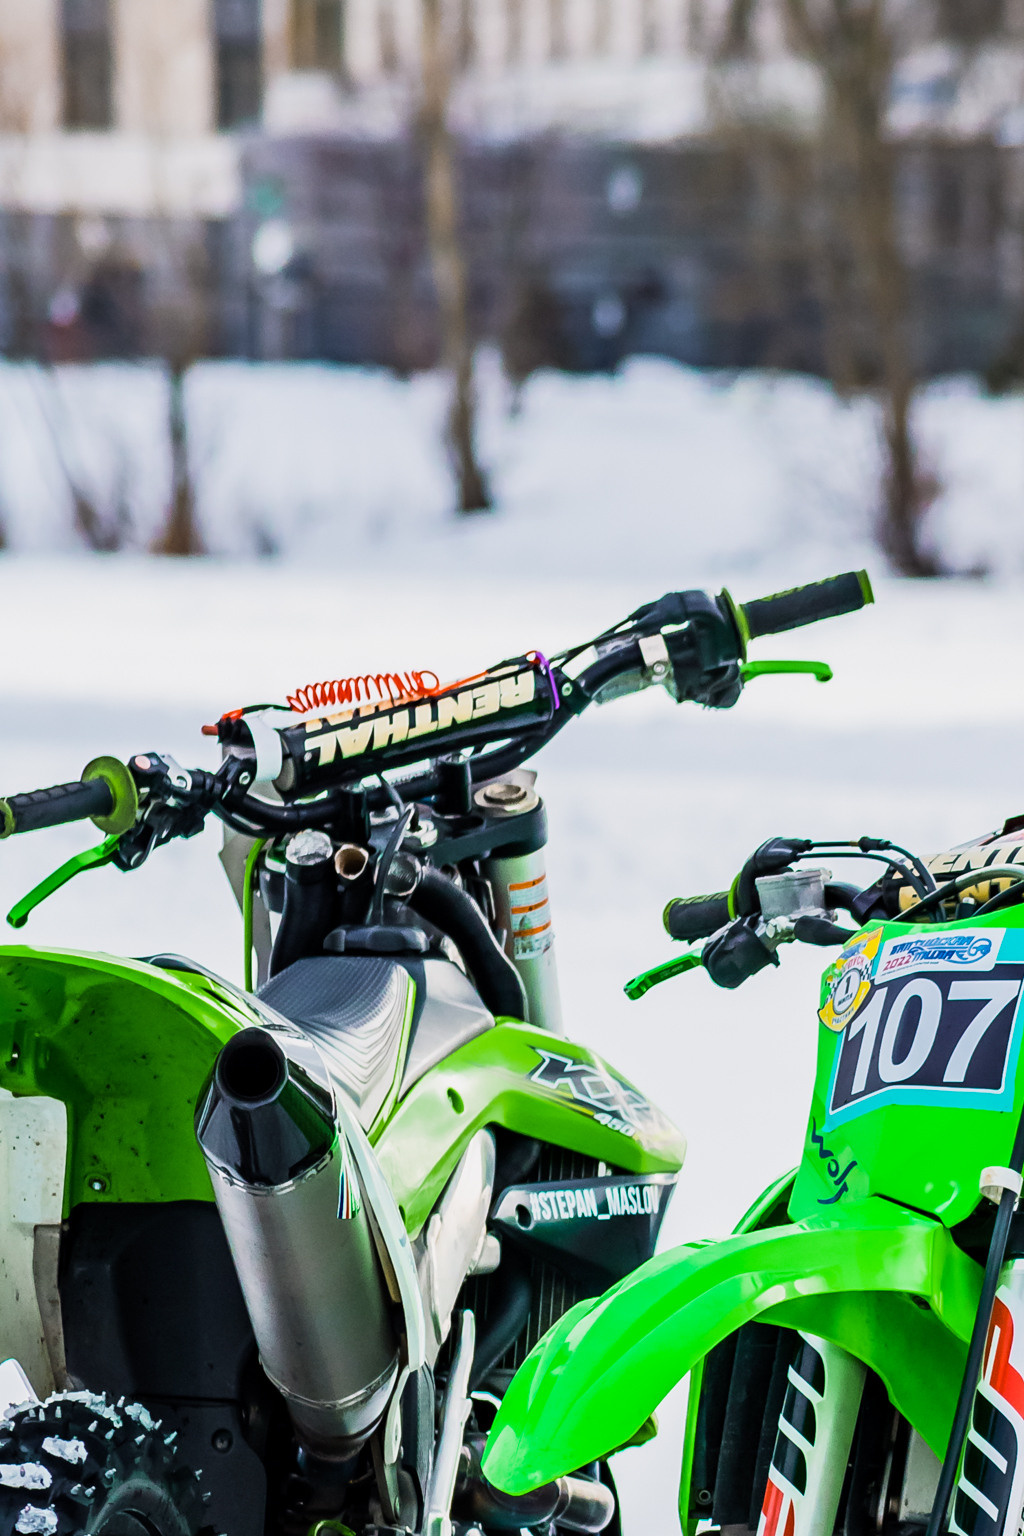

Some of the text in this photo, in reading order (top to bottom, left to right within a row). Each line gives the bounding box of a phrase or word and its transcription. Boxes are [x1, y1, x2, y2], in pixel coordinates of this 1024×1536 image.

[304, 669, 536, 767] RENTHAL
[882, 954, 913, 972] 2022
[847, 977, 1022, 1096] 107
[593, 1111, 637, 1138] 450
[529, 1184, 661, 1221] #STEPAN_MASLOV
